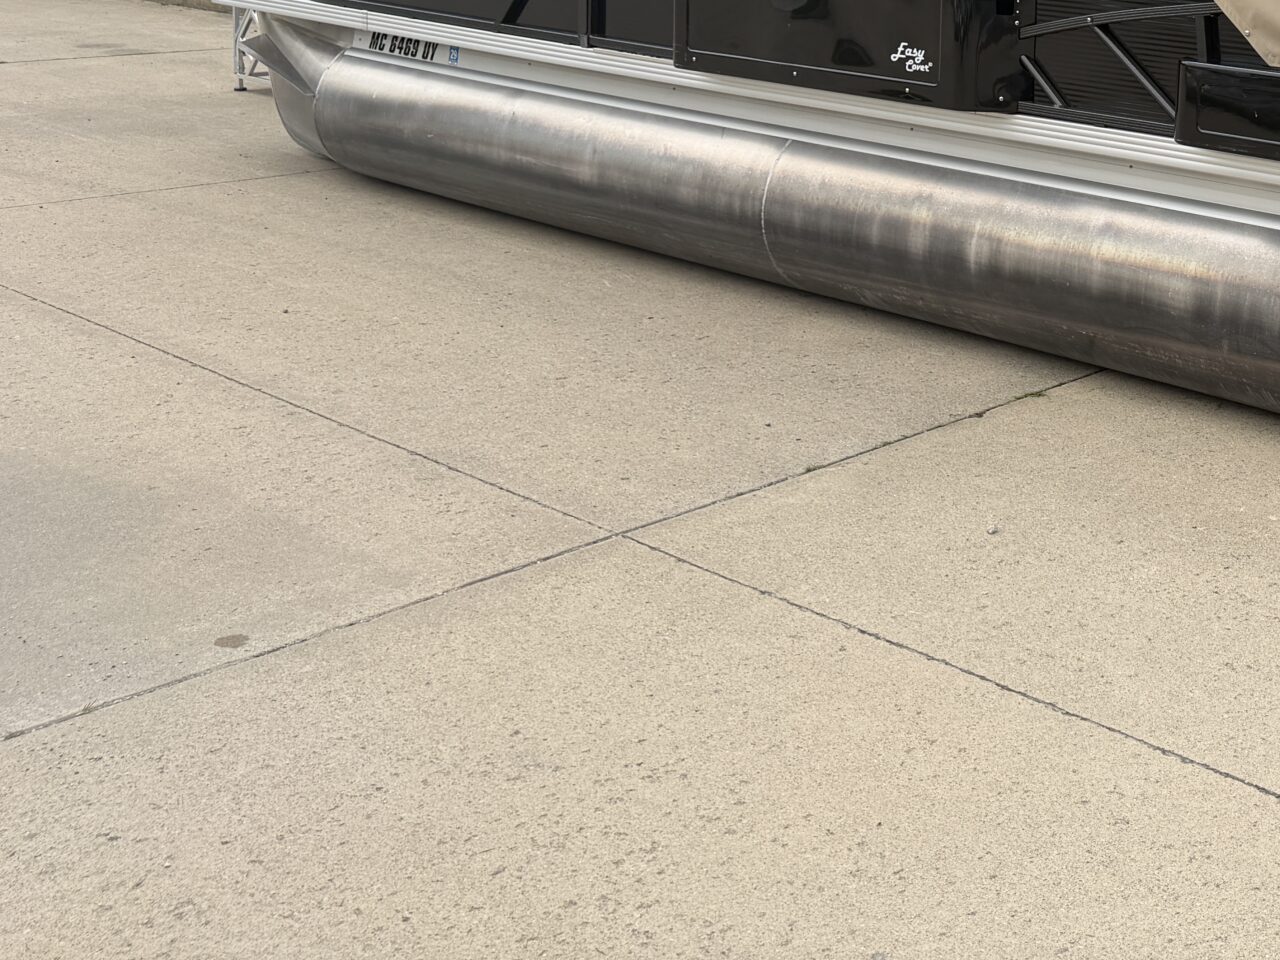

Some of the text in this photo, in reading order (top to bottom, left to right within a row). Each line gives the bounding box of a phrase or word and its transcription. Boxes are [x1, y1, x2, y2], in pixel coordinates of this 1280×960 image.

[369, 31, 439, 61] MC 6469 UY
[890, 41, 925, 64] Easy
